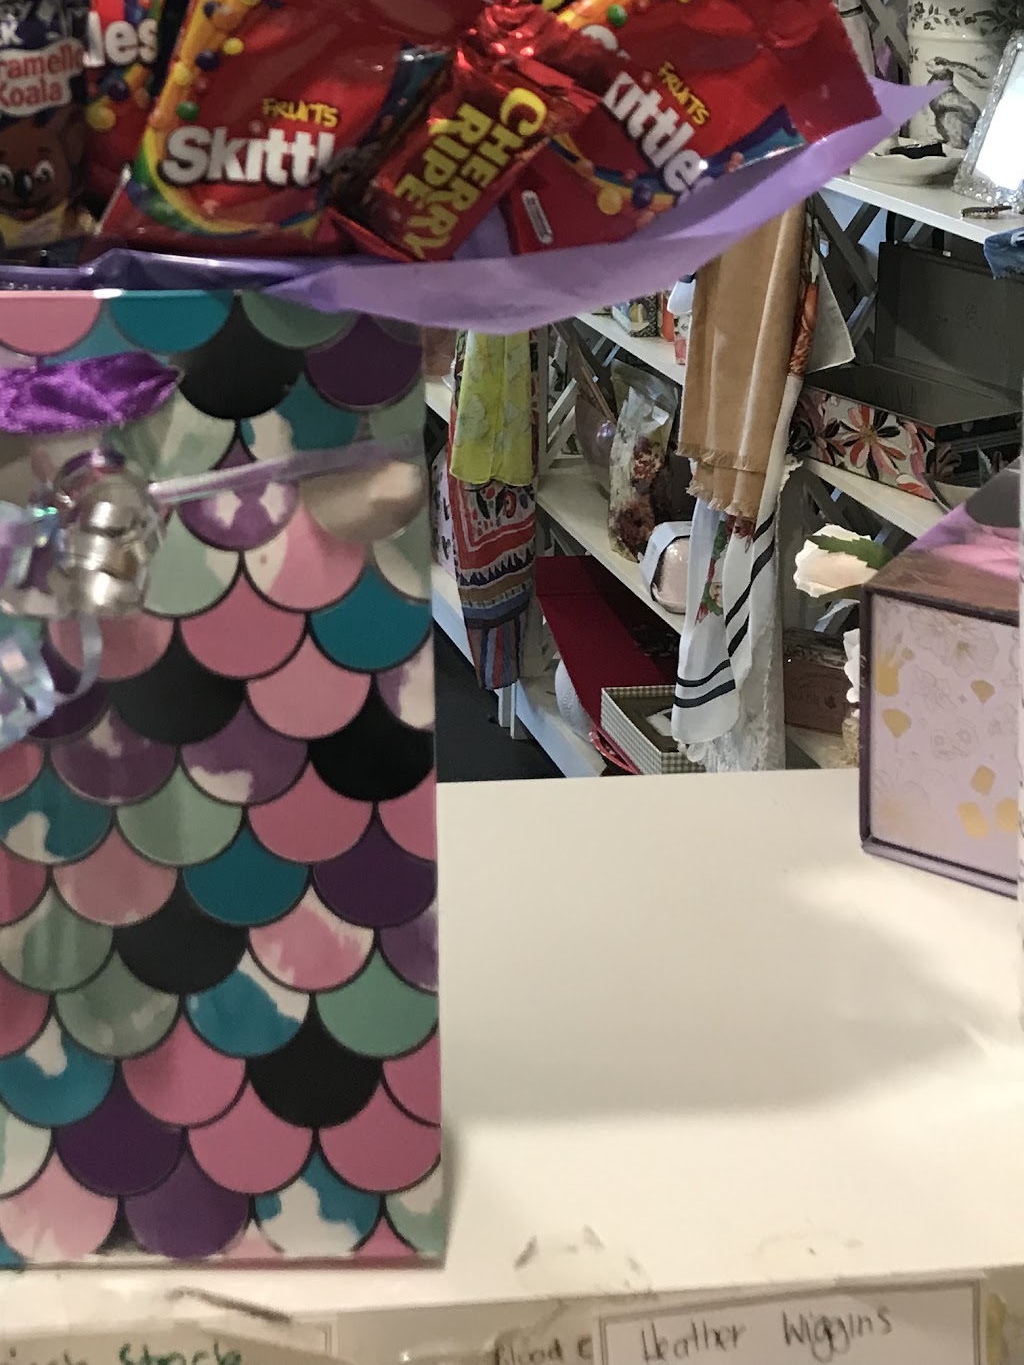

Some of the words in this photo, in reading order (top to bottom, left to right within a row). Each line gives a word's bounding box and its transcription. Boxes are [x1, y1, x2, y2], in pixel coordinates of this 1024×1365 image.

[262, 97, 338, 127] FRUITS
[658, 61, 710, 125] FRUITS
[394, 103, 493, 210] RIPE
[403, 87, 547, 260] CHERRY
[640, 1319, 747, 1363] Heather
[782, 1305, 893, 1363] Wiggins
